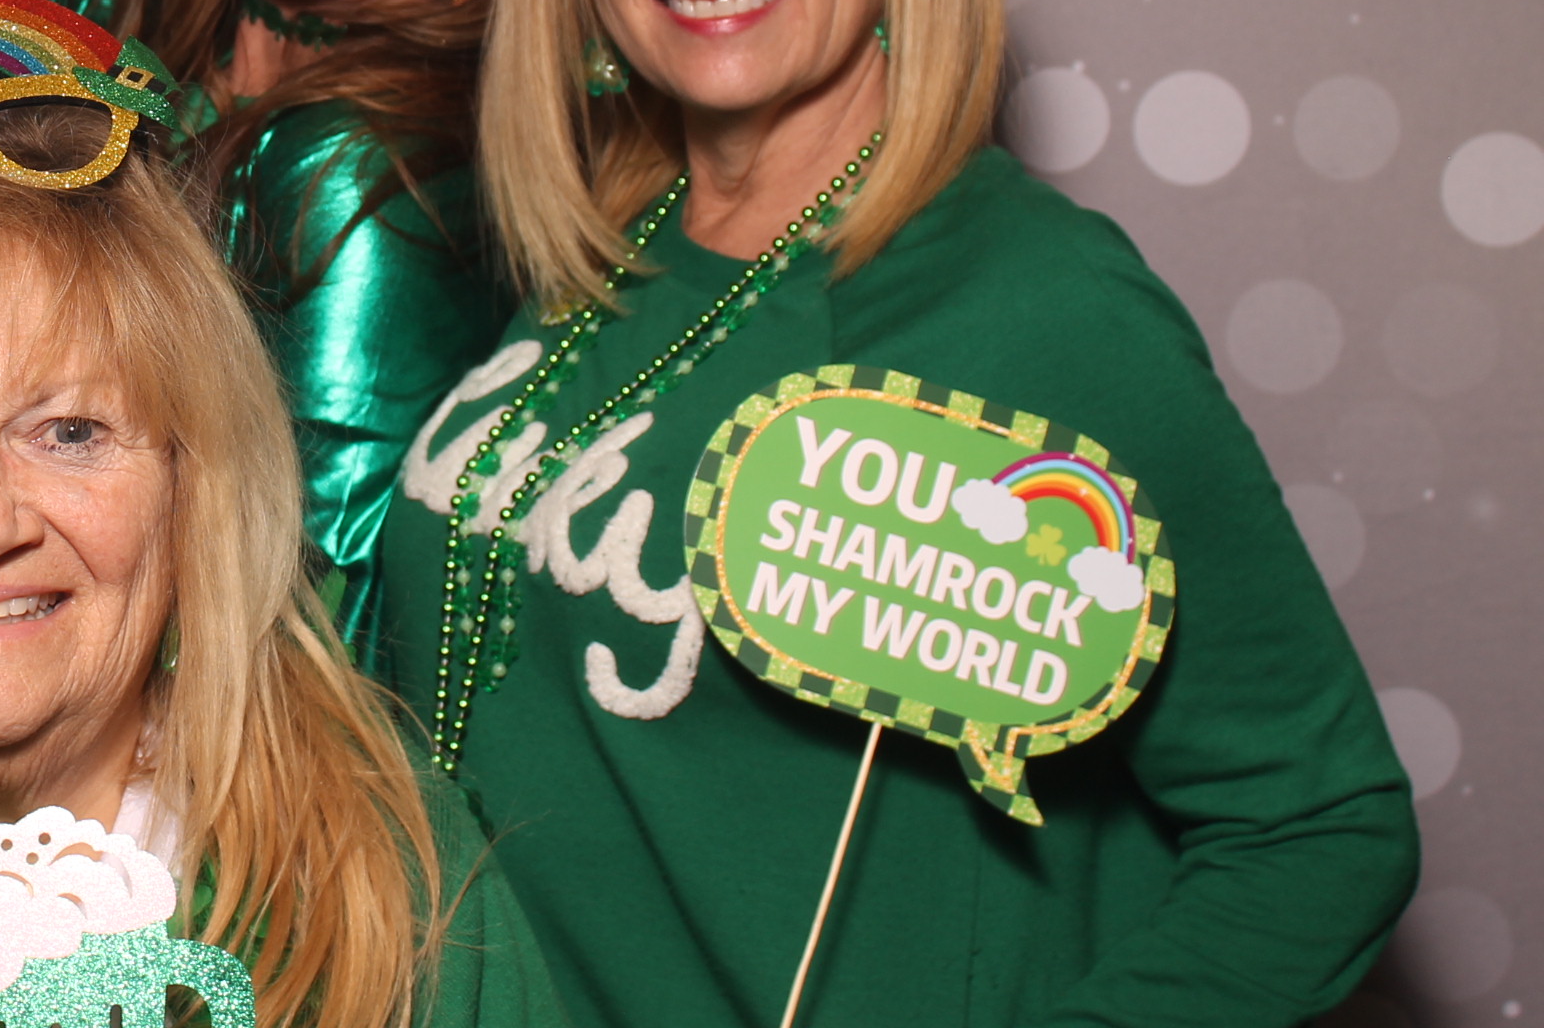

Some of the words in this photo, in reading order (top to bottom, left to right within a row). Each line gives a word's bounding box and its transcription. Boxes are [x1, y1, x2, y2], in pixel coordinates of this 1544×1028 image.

[796, 415, 957, 524] YOU
[746, 560, 855, 635] MY
[861, 596, 1068, 705] WORLD
[759, 499, 1093, 647] SHAMROCK
